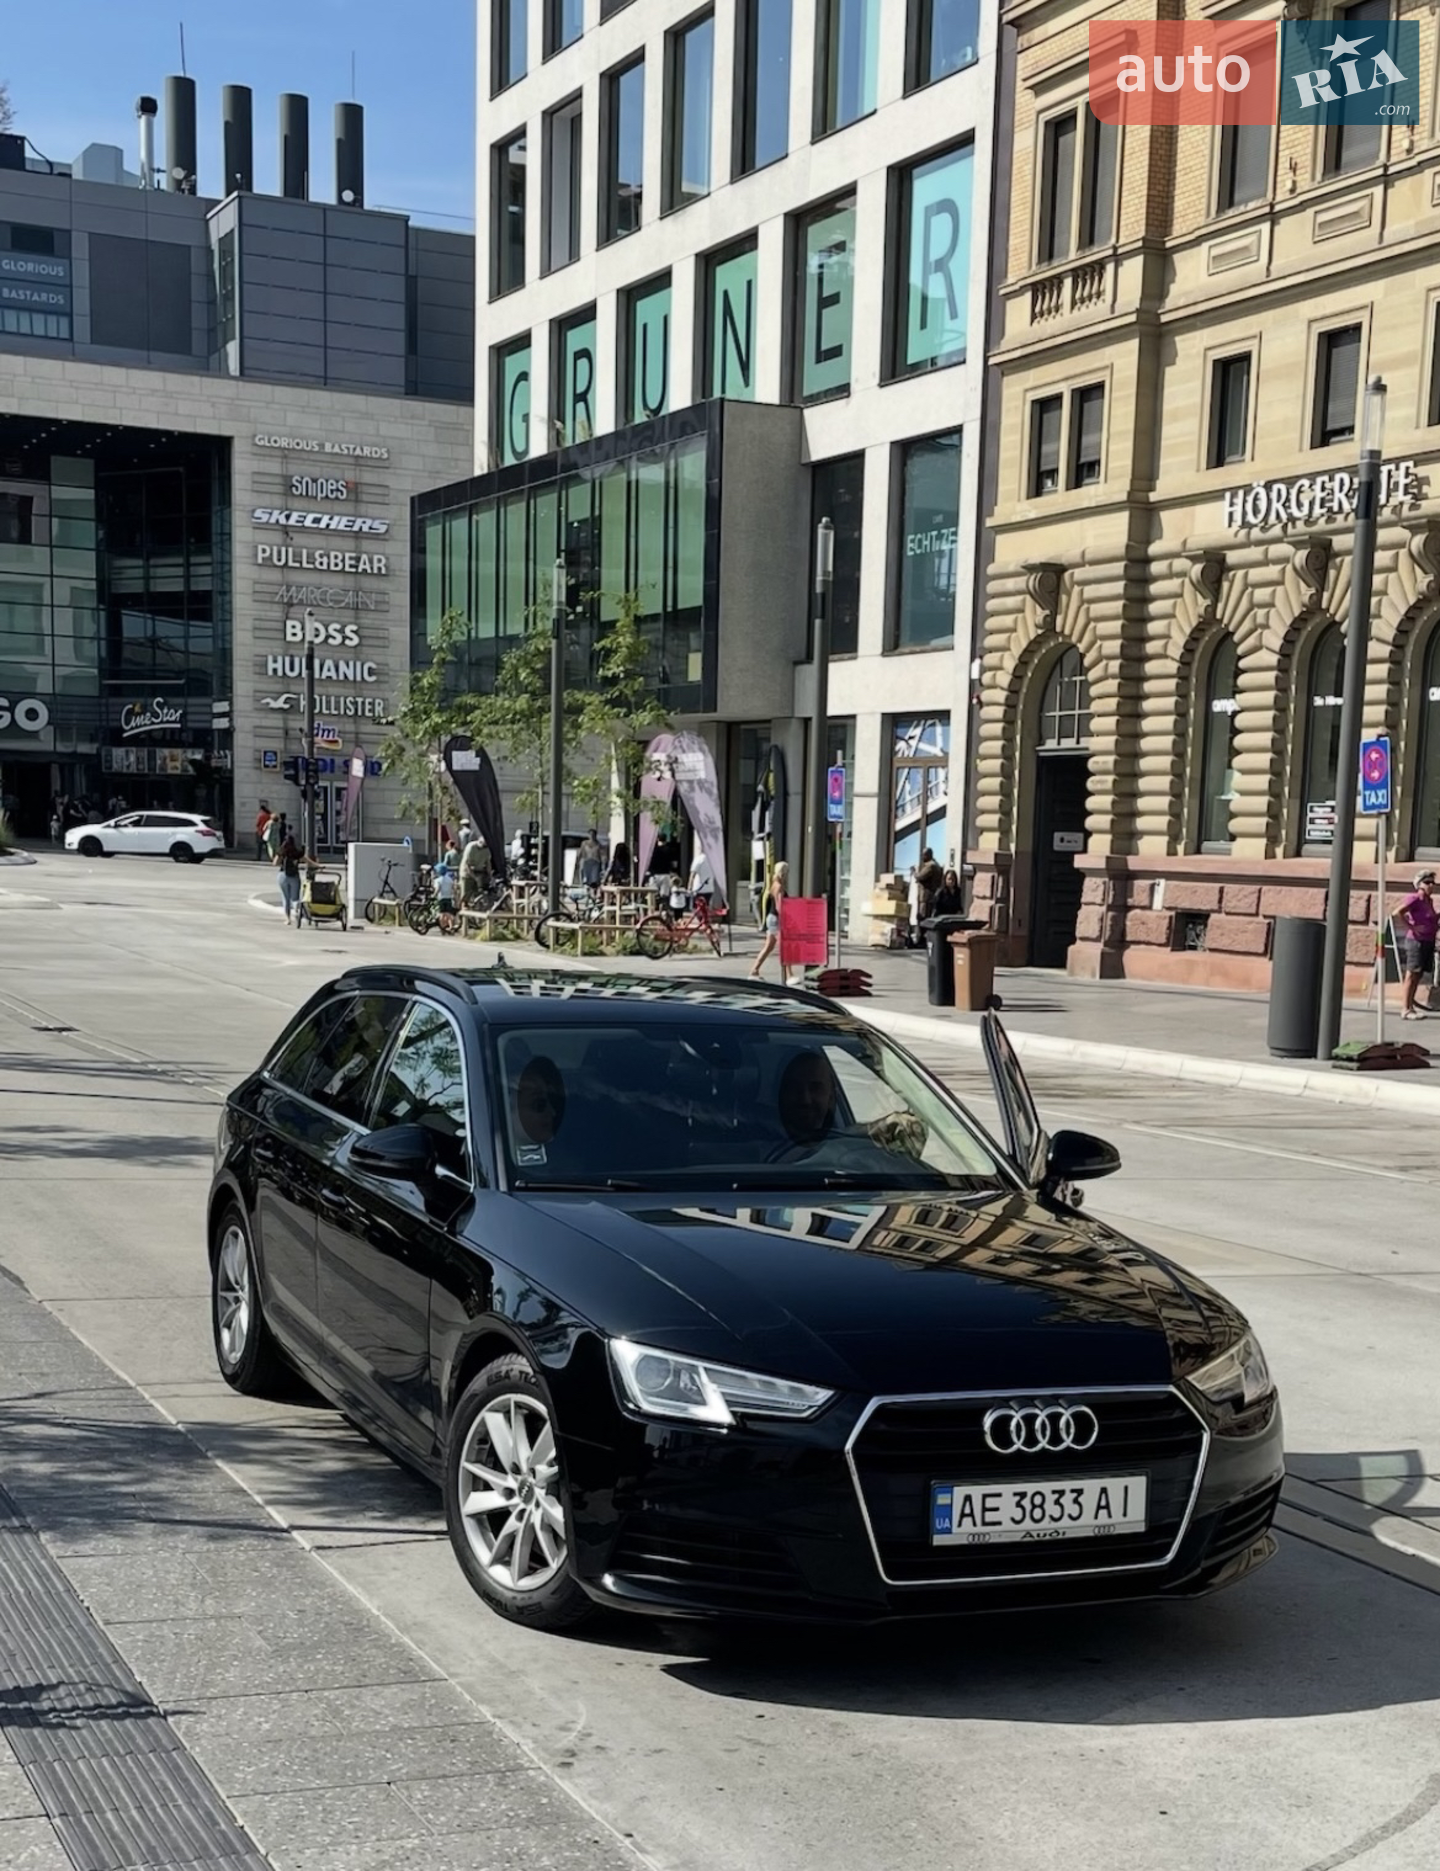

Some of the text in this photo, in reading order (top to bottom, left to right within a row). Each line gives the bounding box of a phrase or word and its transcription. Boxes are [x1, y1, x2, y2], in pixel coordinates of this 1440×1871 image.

[1, 259, 65, 277] GLORIOUS
[2, 287, 65, 305] BASTARDS
[255, 434, 389, 459] GLORIOUS BASTARDS
[251, 508, 390, 533] SKECHERS
[256, 544, 387, 574] PULL&BEAR
[285, 619, 360, 647] BOSS
[1364, 788, 1388, 806] TAXI
[956, 1493, 1003, 1529] AE
[1010, 1487, 1084, 1526] 3833
[935, 1517, 952, 1530] UA
